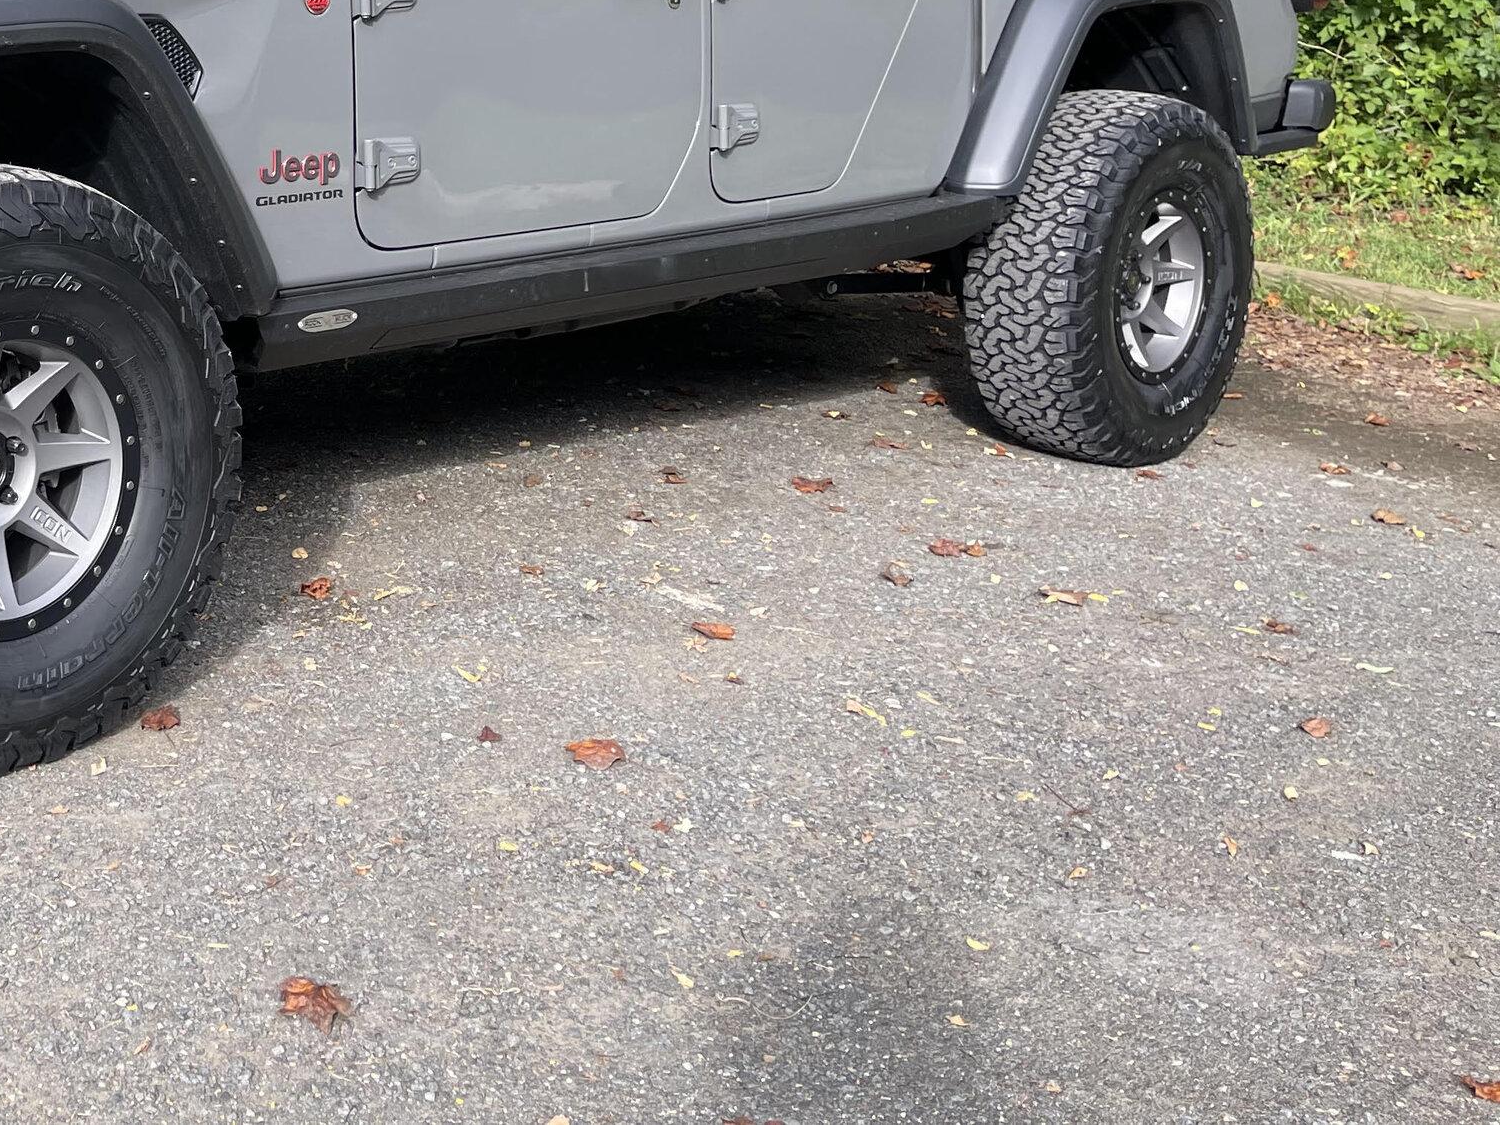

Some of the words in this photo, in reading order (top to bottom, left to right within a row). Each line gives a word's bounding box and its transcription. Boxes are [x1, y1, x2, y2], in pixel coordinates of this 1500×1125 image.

[259, 148, 340, 186] Jeep
[256, 189, 344, 206] GLADIATOR
[29, 505, 73, 543] ICON
